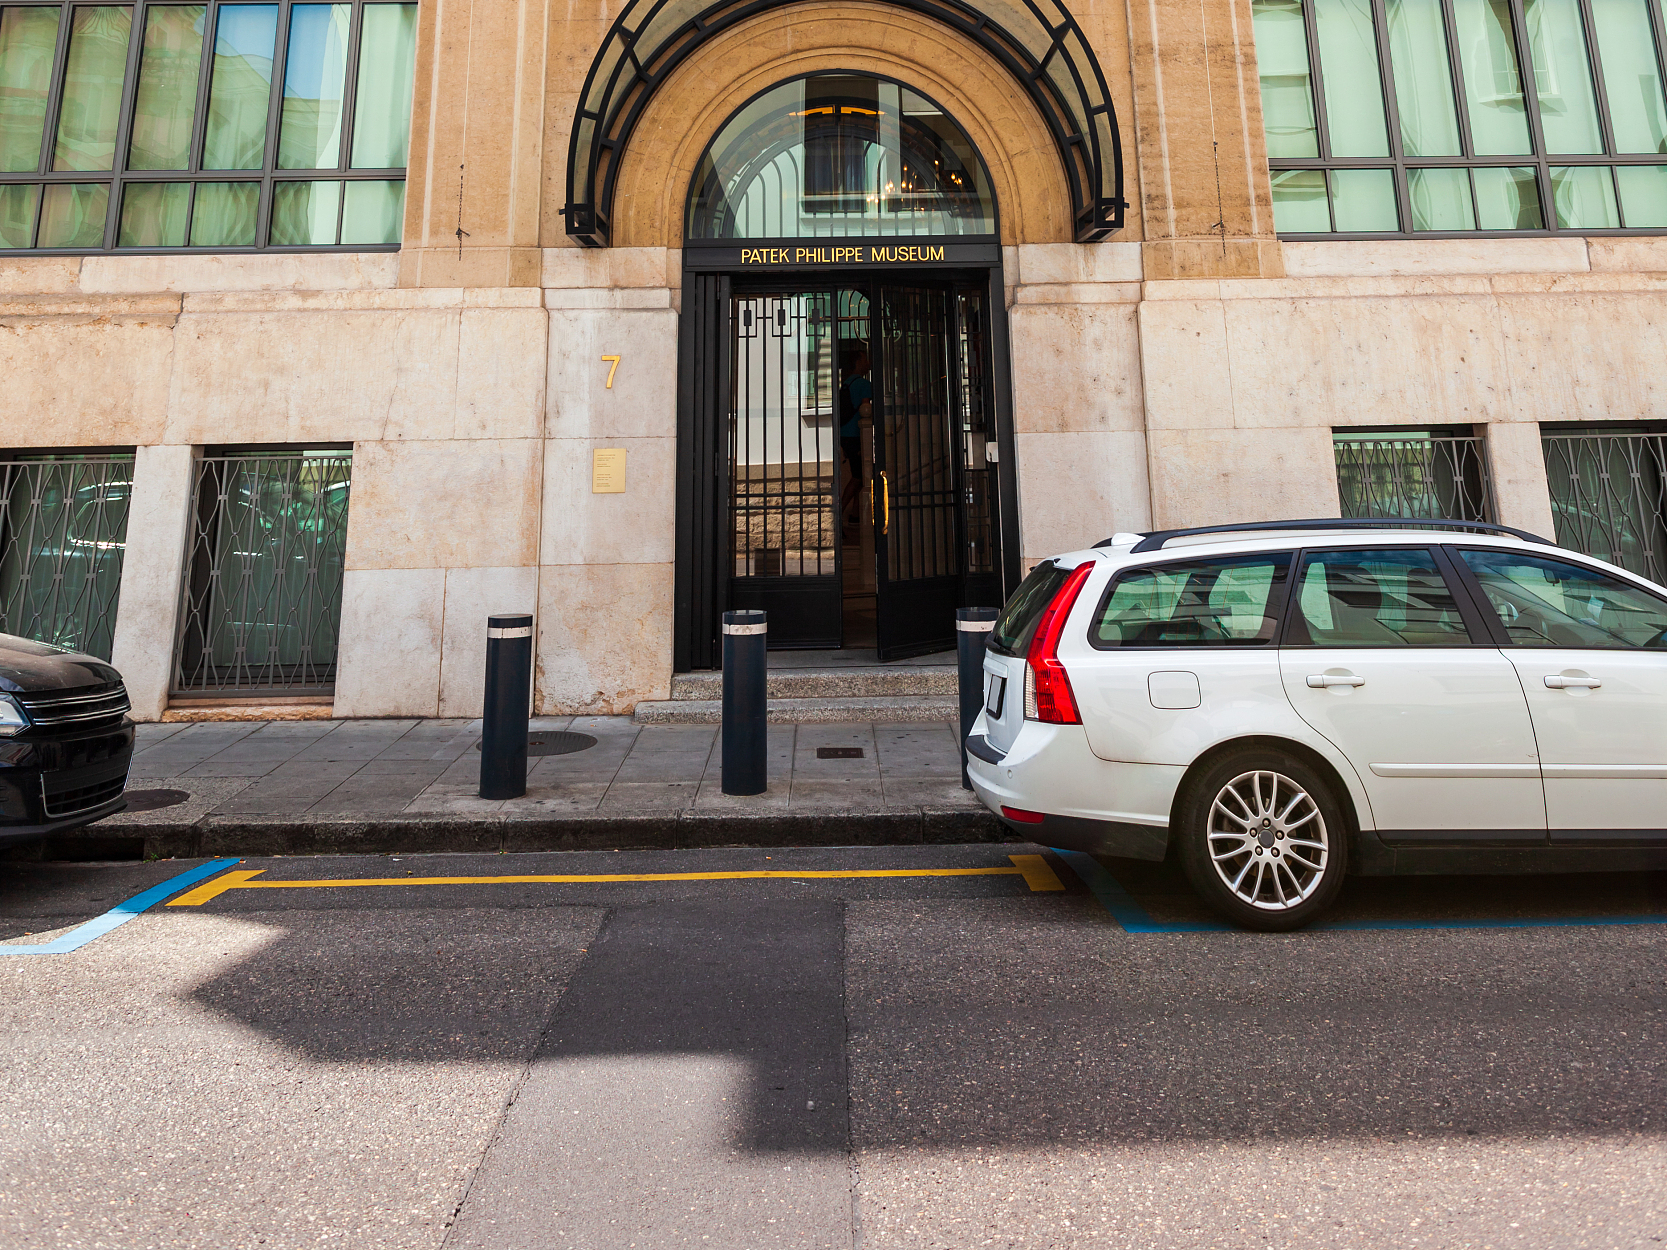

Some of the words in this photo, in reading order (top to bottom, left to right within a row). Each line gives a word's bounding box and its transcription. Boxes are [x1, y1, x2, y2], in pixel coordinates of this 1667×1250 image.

[741, 248, 790, 264] PATEK
[795, 247, 864, 263] PHILIPPE
[871, 246, 945, 262] MUSEUM
[601, 355, 621, 389] 7
